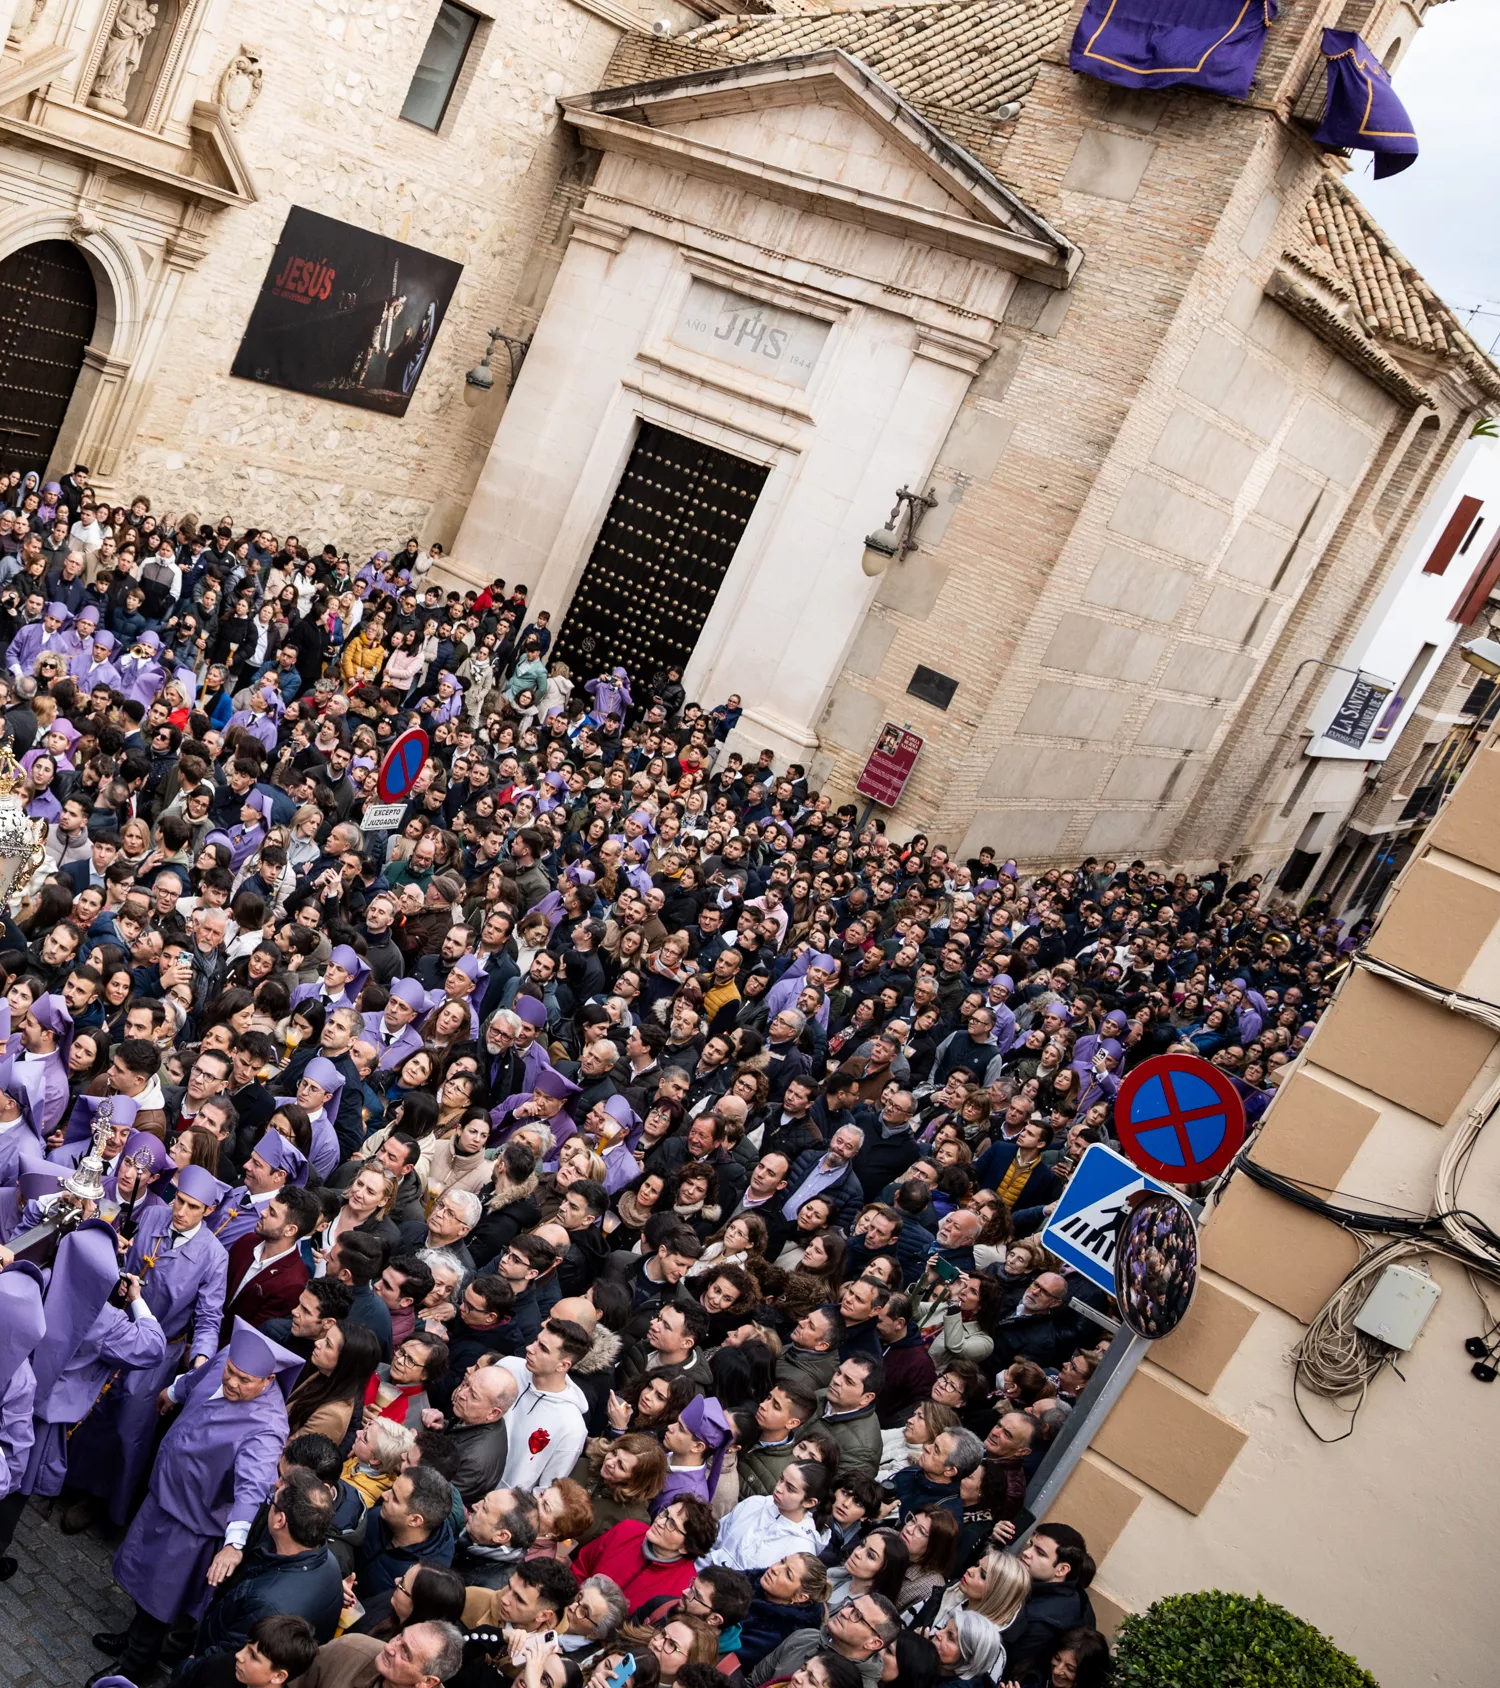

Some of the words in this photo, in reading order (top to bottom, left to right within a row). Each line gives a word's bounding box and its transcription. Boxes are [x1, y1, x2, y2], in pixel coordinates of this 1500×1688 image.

[276, 255, 336, 300] JESÚS
[685, 318, 707, 333] AÑO
[790, 355, 812, 369] 1844
[1340, 681, 1372, 719] SANTER
[1373, 690, 1386, 700] SE
[367, 817, 400, 826] JUZGADOS
[373, 808, 401, 817] EXCEPTO
